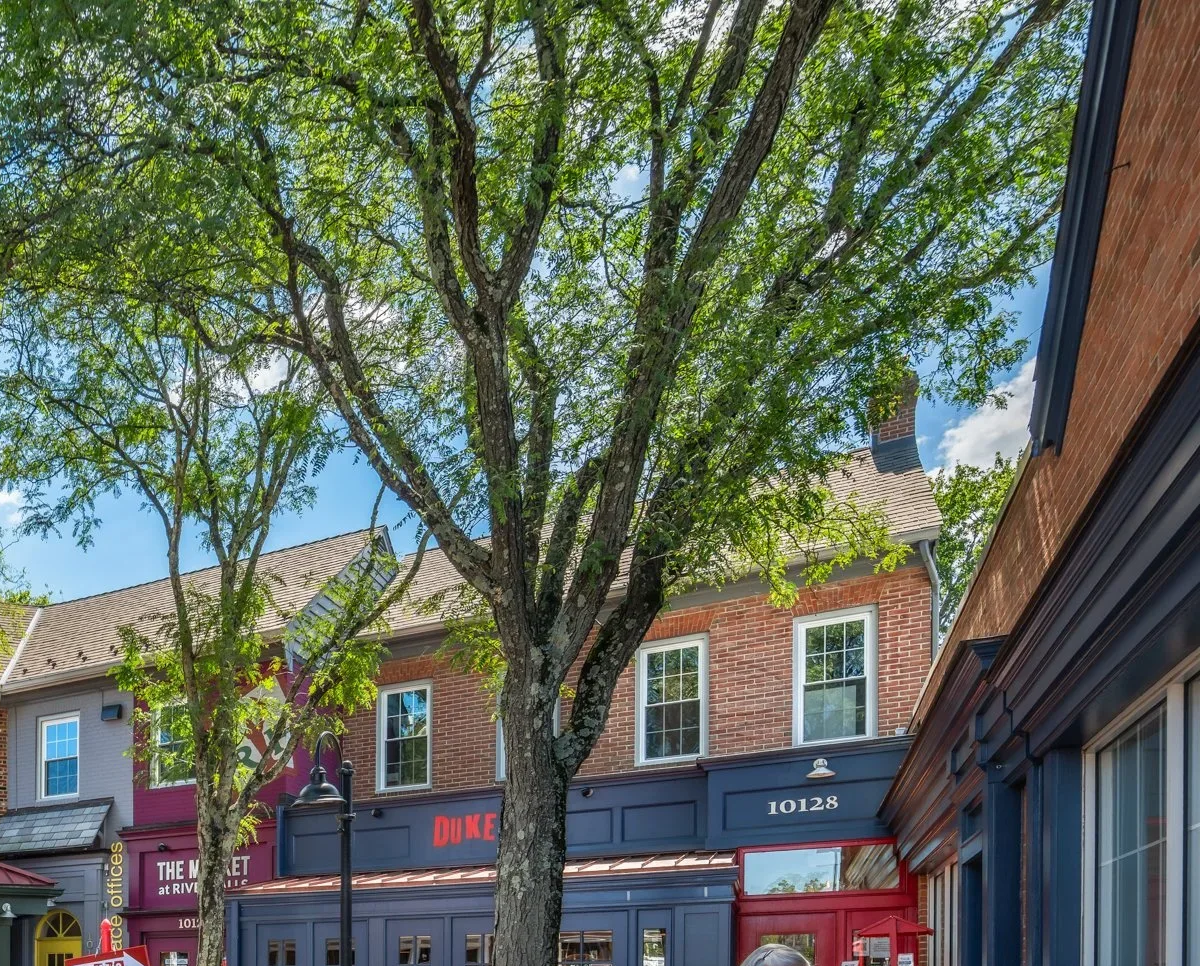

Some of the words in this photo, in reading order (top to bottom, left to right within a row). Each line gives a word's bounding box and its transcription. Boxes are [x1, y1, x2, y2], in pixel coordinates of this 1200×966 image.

[767, 795, 839, 815] 10128
[107, 841, 123, 908] offices
[157, 861, 184, 881] THE
[189, 856, 250, 879] MET
[158, 884, 170, 895] at
[111, 915, 123, 951] ace
